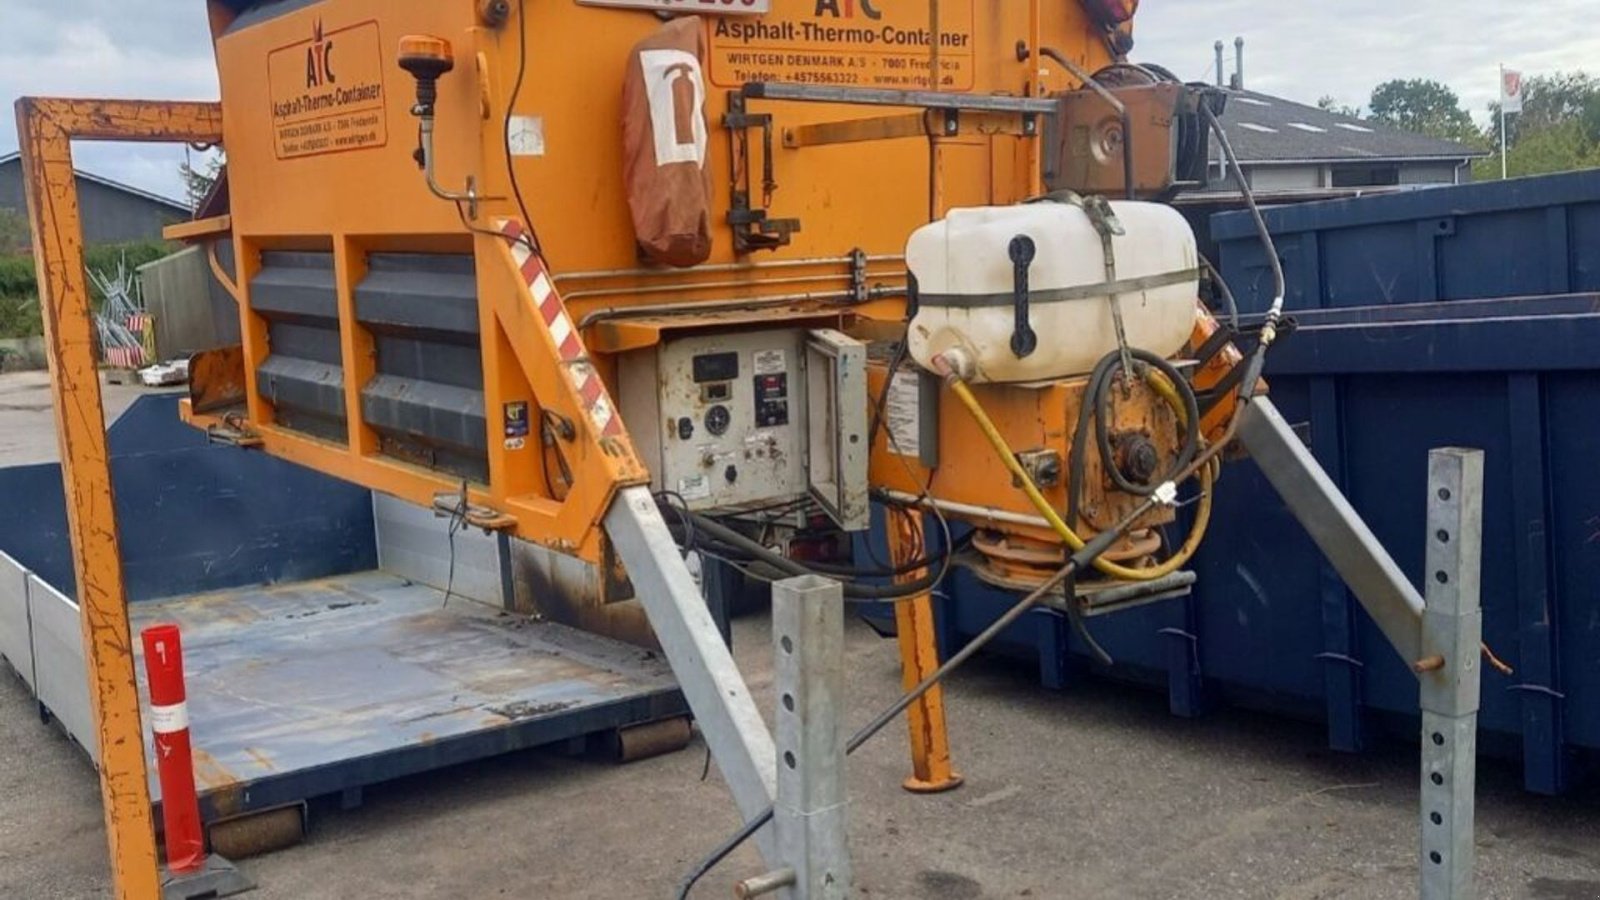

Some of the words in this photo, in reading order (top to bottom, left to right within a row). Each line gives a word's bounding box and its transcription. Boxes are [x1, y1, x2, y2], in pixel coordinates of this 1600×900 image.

[714, 17, 969, 47] Asphalt-Thermo-Contaner
[307, 41, 335, 88] ATC
[726, 52, 785, 67] WIRTGEN
[786, 54, 845, 68] DENMARK
